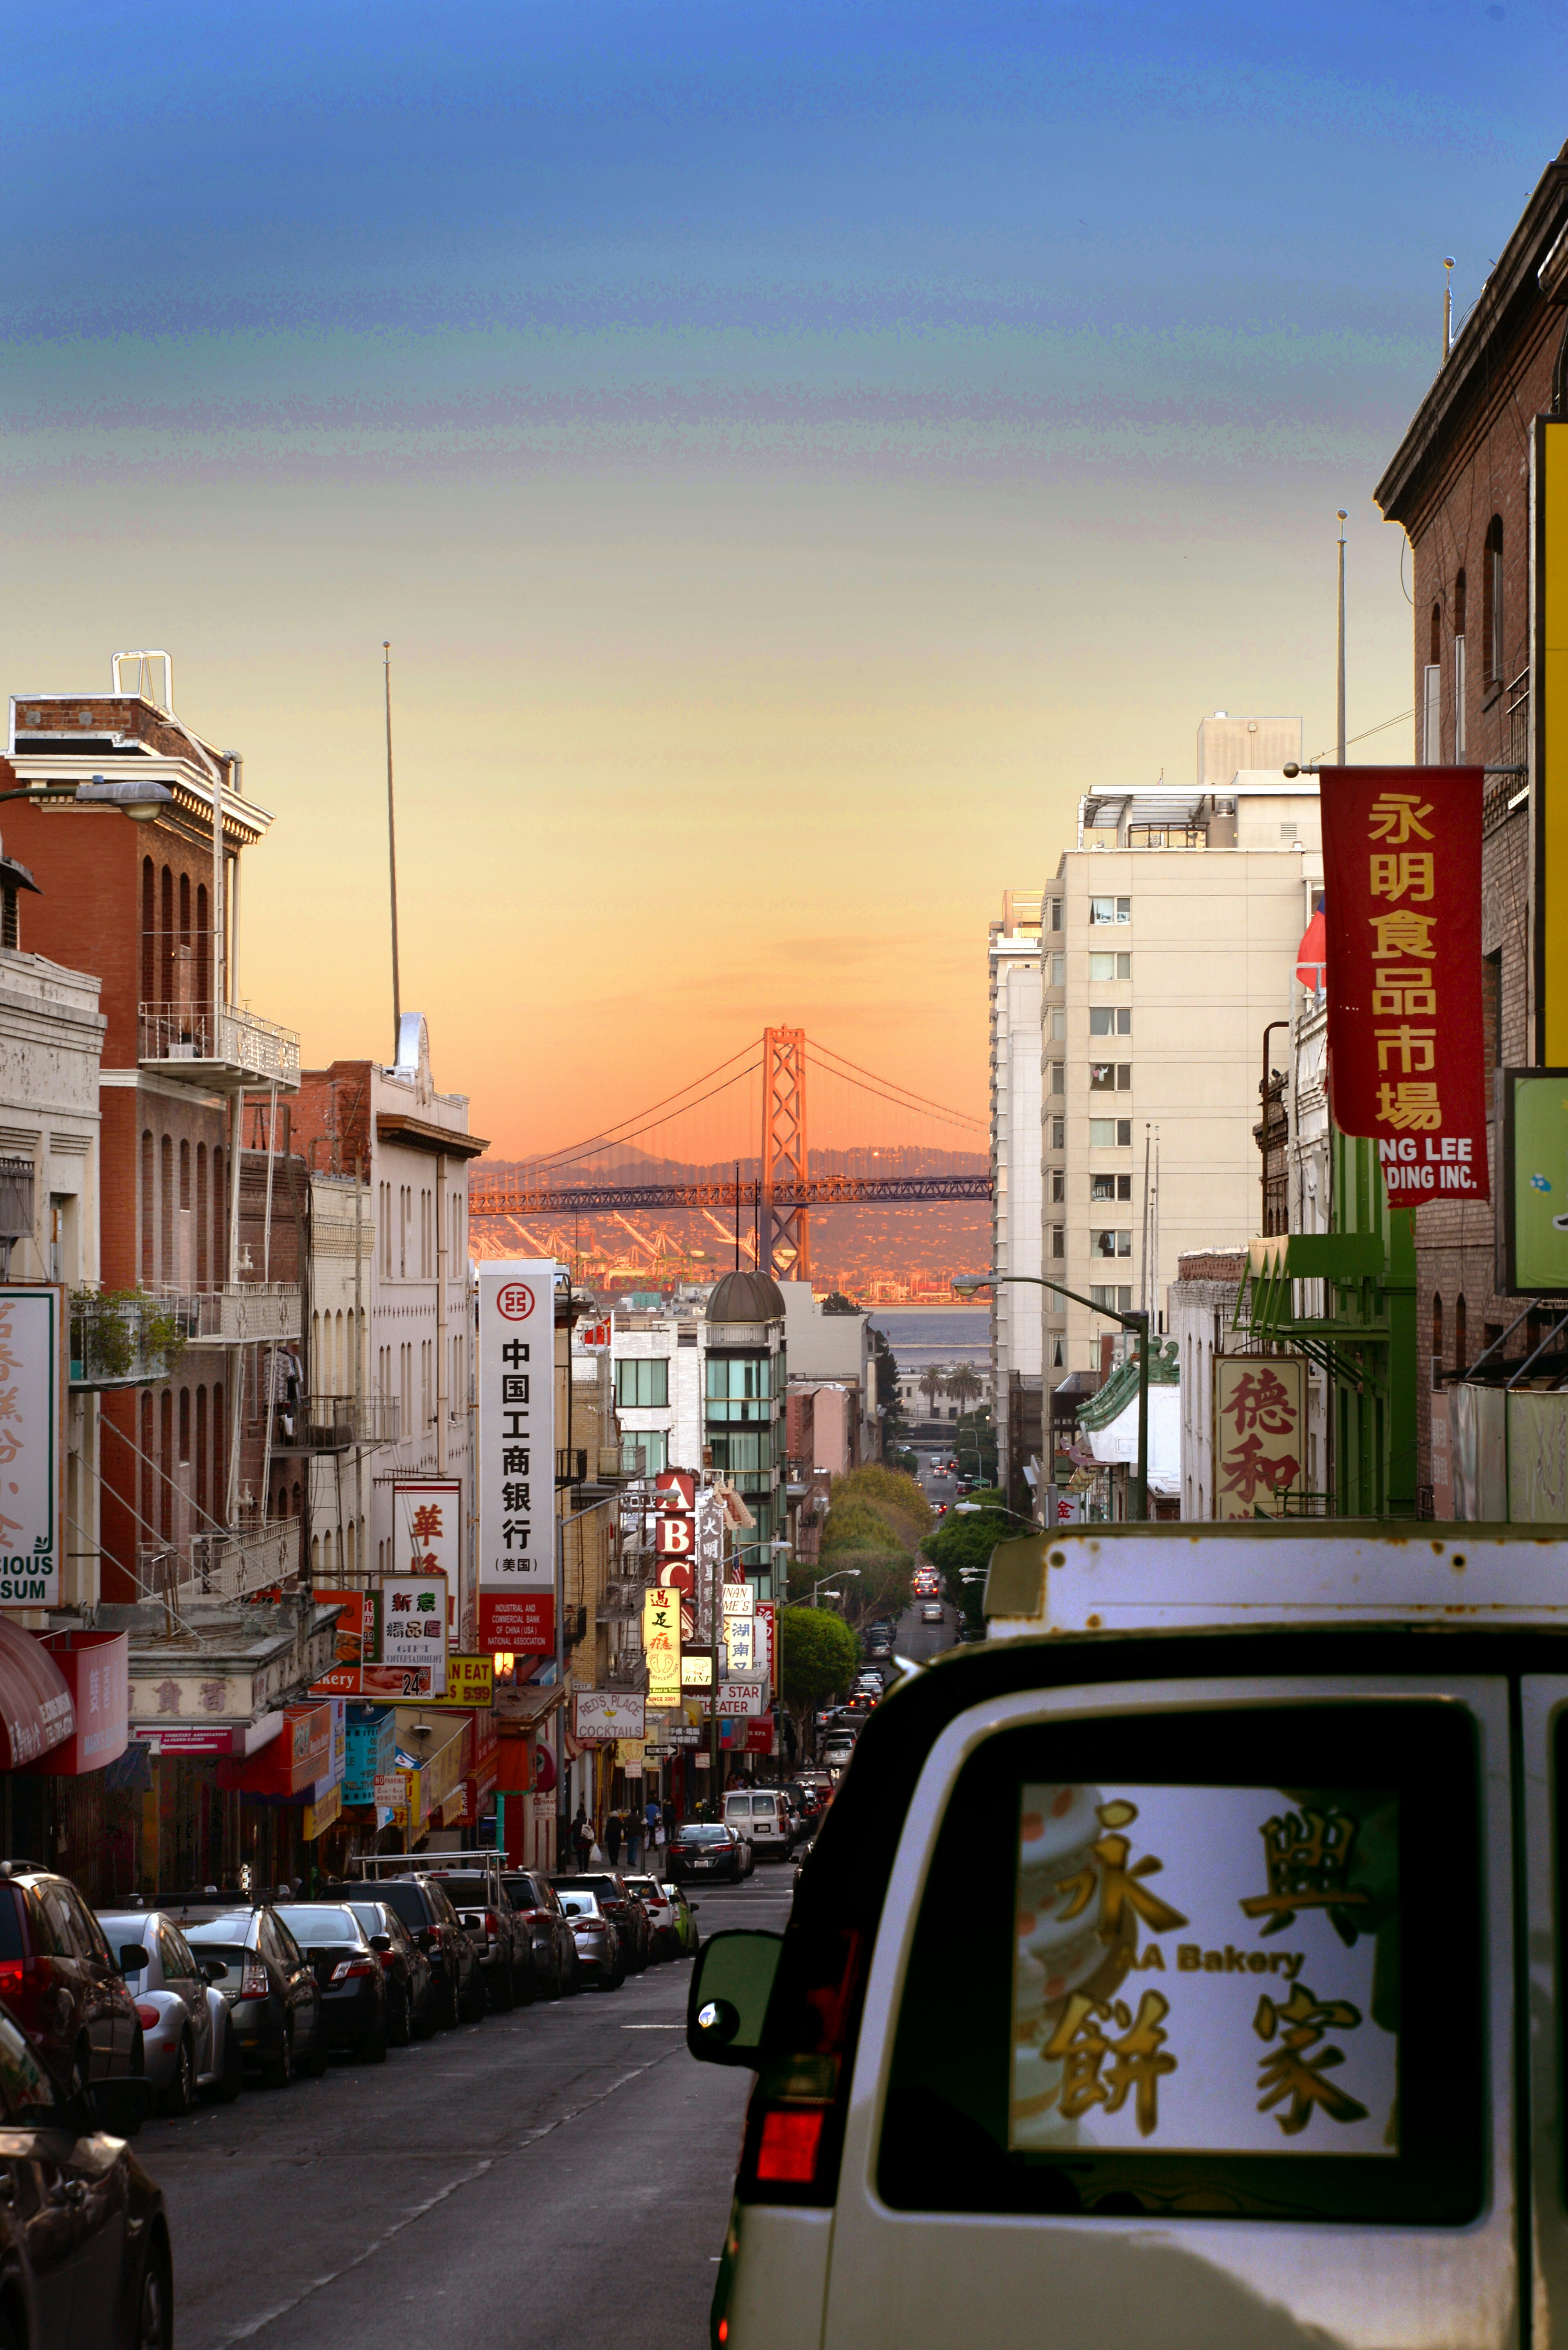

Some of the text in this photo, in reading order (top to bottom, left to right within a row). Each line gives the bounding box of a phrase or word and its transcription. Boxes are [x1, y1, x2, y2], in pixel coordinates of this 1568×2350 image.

[1367, 793, 1442, 1130] 永明食品市場
[1379, 1138, 1472, 1161] NG LEE
[1387, 1166, 1477, 1189] DING INC.
[502, 1339, 531, 1550] 中国工商银行
[1218, 1368, 1300, 1521] 德和
[0, 1557, 53, 1575] IOUS
[0, 1580, 45, 1599] SUM
[392, 1592, 436, 1612] 新意
[495, 1604, 523, 1612] INDUSTRIAL
[386, 1620, 442, 1638] 精品屋
[496, 1626, 503, 1634] OF
[505, 1626, 520, 1634] CHINA
[397, 1644, 431, 1653] GIFT
[488, 1637, 546, 1645] NATIONAL ASSOCIATION
[386, 1655, 442, 1663] ENTERTAINMENT
[449, 1664, 489, 1680] N EAT
[402, 1673, 420, 1696] 24
[419, 1669, 429, 1678] 99
[450, 1684, 490, 1700] $ 5.99
[729, 1686, 759, 1698] STAR
[579, 1695, 643, 1717] RED'S PLACE
[579, 1726, 642, 1738] COCKTAILS
[375, 1776, 384, 1784] NO
[1177, 1943, 1306, 1982] Bakery
